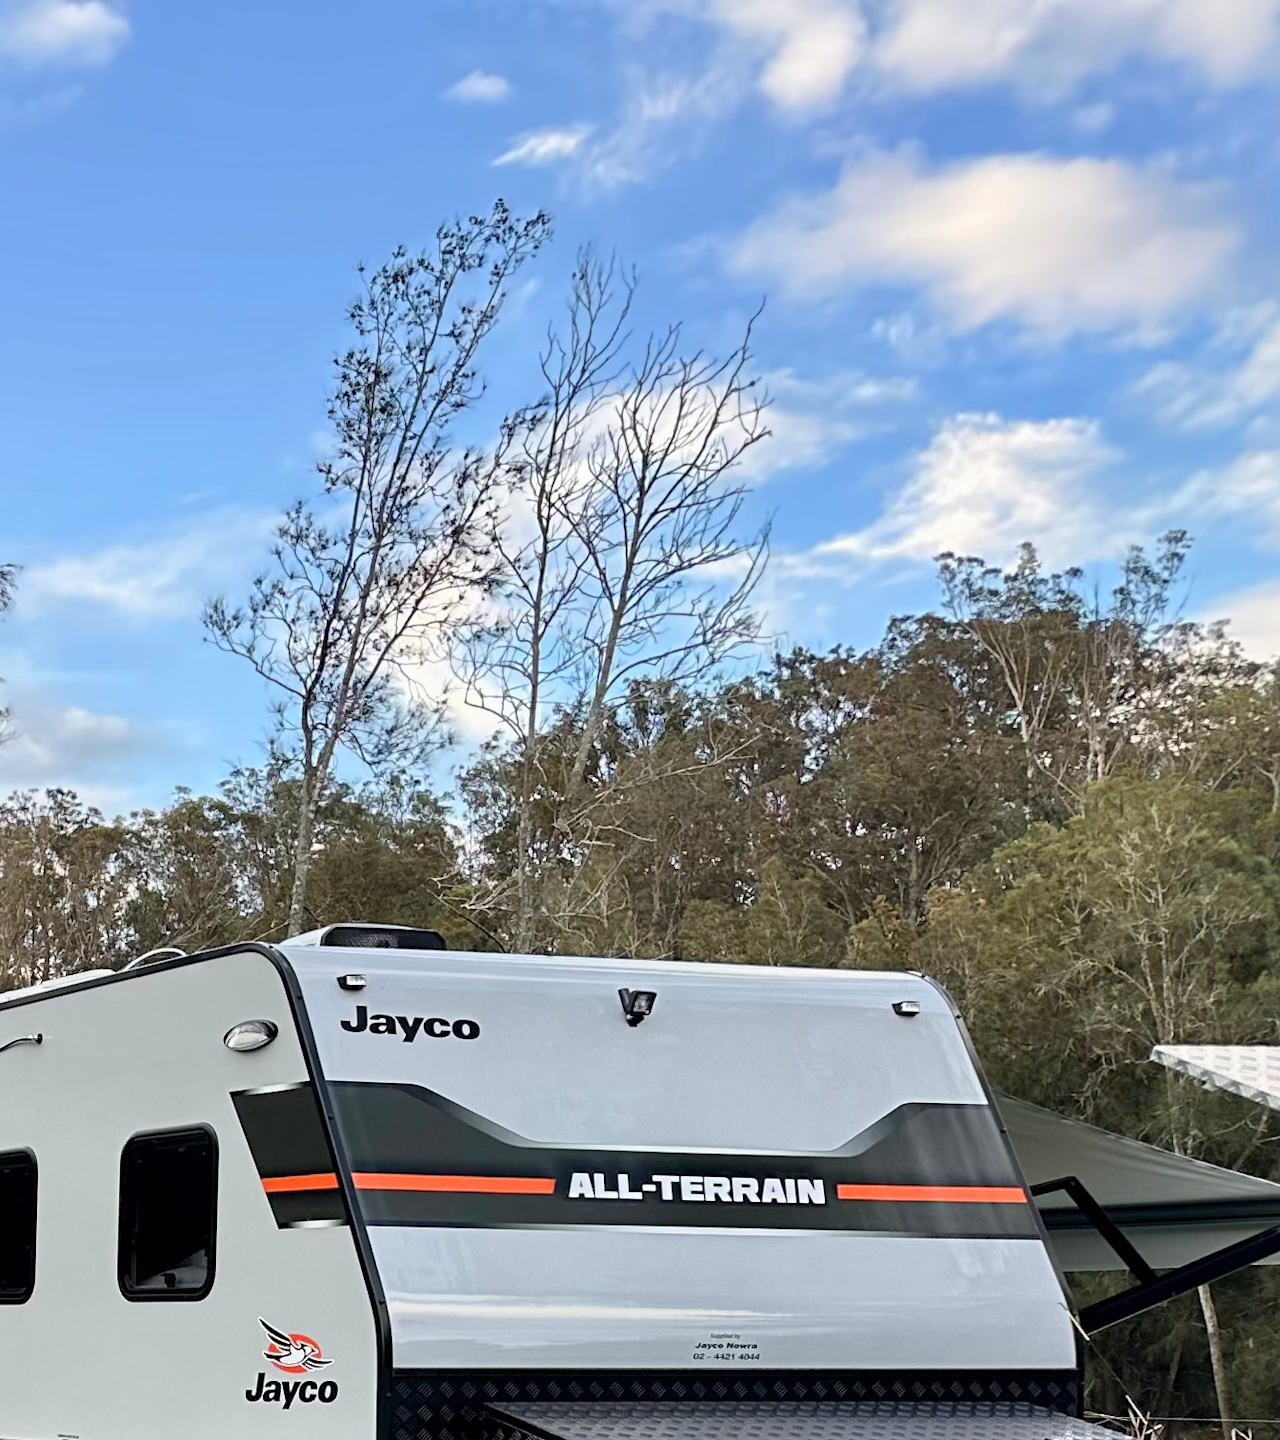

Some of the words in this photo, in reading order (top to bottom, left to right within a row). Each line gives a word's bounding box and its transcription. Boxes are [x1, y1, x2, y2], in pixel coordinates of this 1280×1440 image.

[340, 1005, 481, 1043] Jayco
[568, 1172, 826, 1205] ALL-TERRAIN
[695, 1342, 724, 1350] Jayco
[245, 1372, 339, 1410] Jayco
